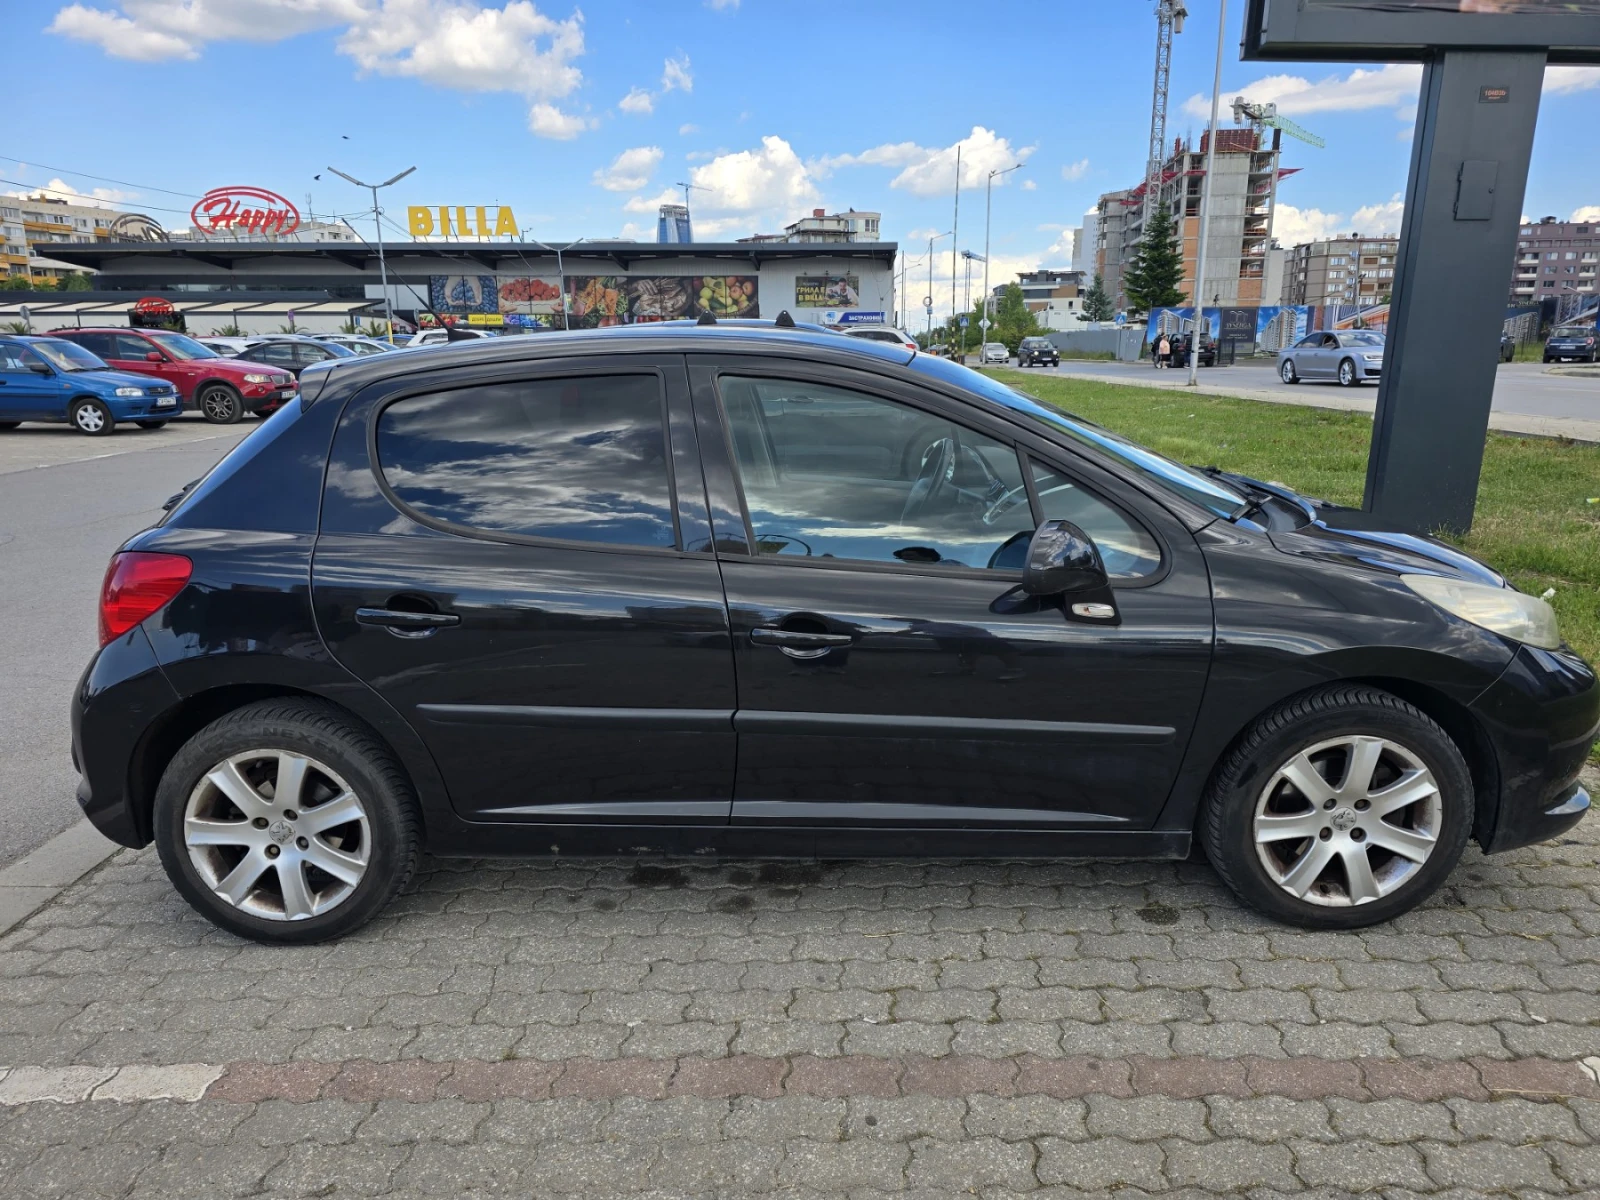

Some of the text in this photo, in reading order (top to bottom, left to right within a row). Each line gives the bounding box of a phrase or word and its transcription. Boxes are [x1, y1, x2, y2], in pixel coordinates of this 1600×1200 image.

[203, 197, 290, 234] Happy
[407, 206, 520, 236] BILLA
[262, 727, 345, 758] NEXEN
